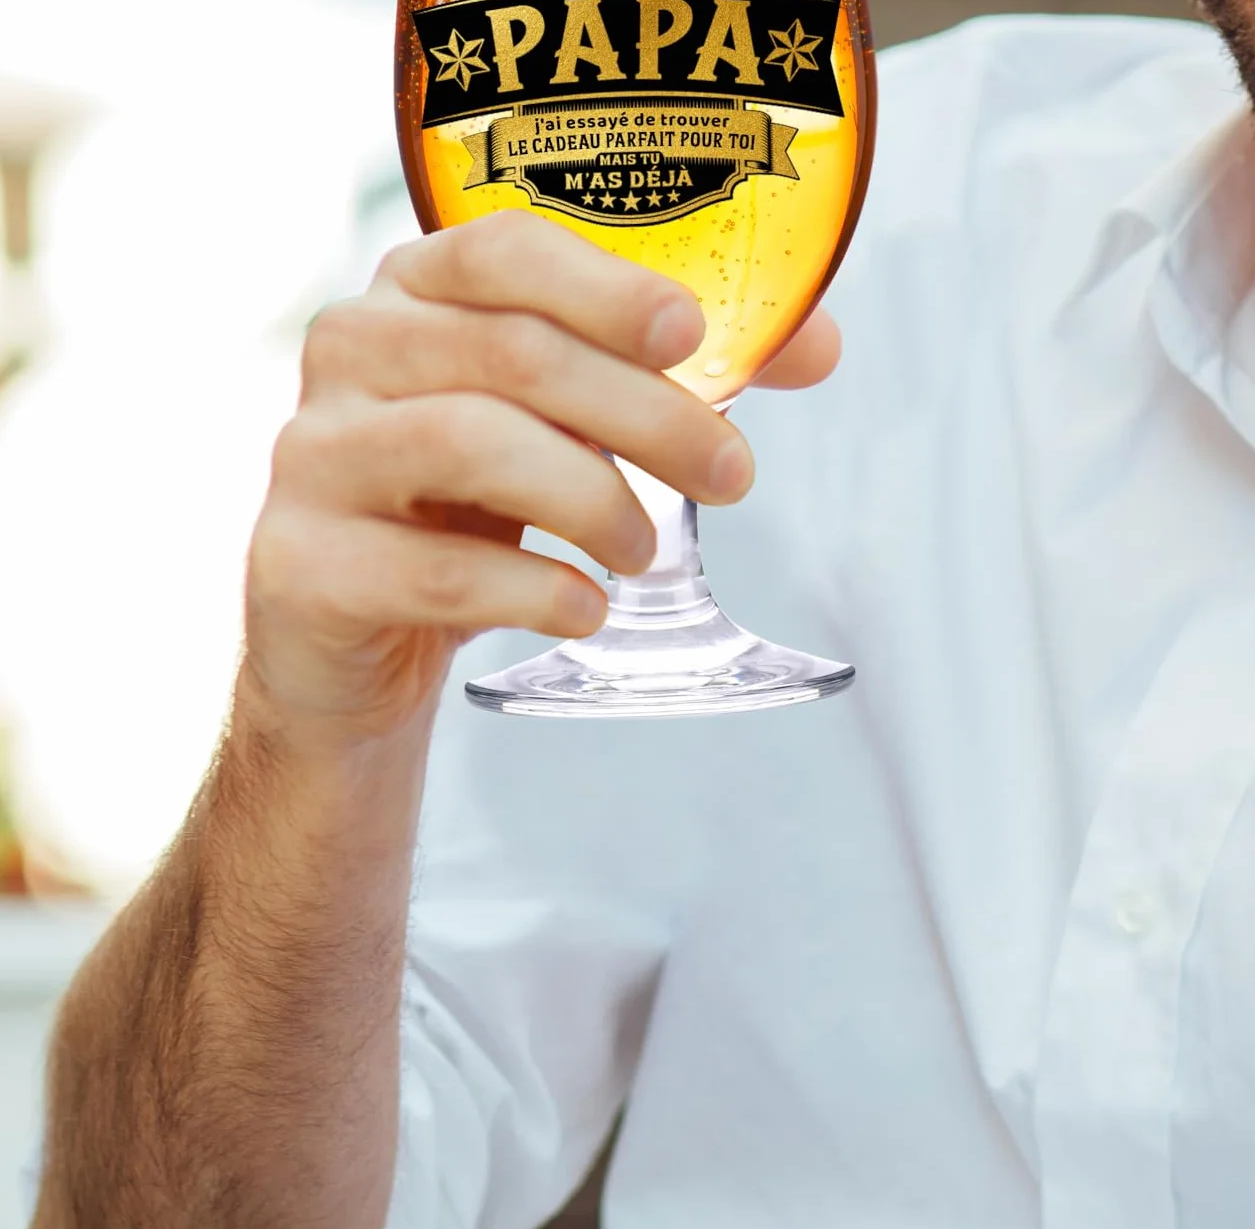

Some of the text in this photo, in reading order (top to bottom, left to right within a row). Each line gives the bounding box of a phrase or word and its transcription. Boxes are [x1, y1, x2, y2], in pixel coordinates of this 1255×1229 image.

[535, 112, 730, 136] j'ai essayé de trouver
[508, 130, 755, 156] LE CADEAU PARFAIT POUR TOI
[599, 152, 661, 166] MAIS TU
[564, 166, 693, 190] M'AS DÉJÀ
